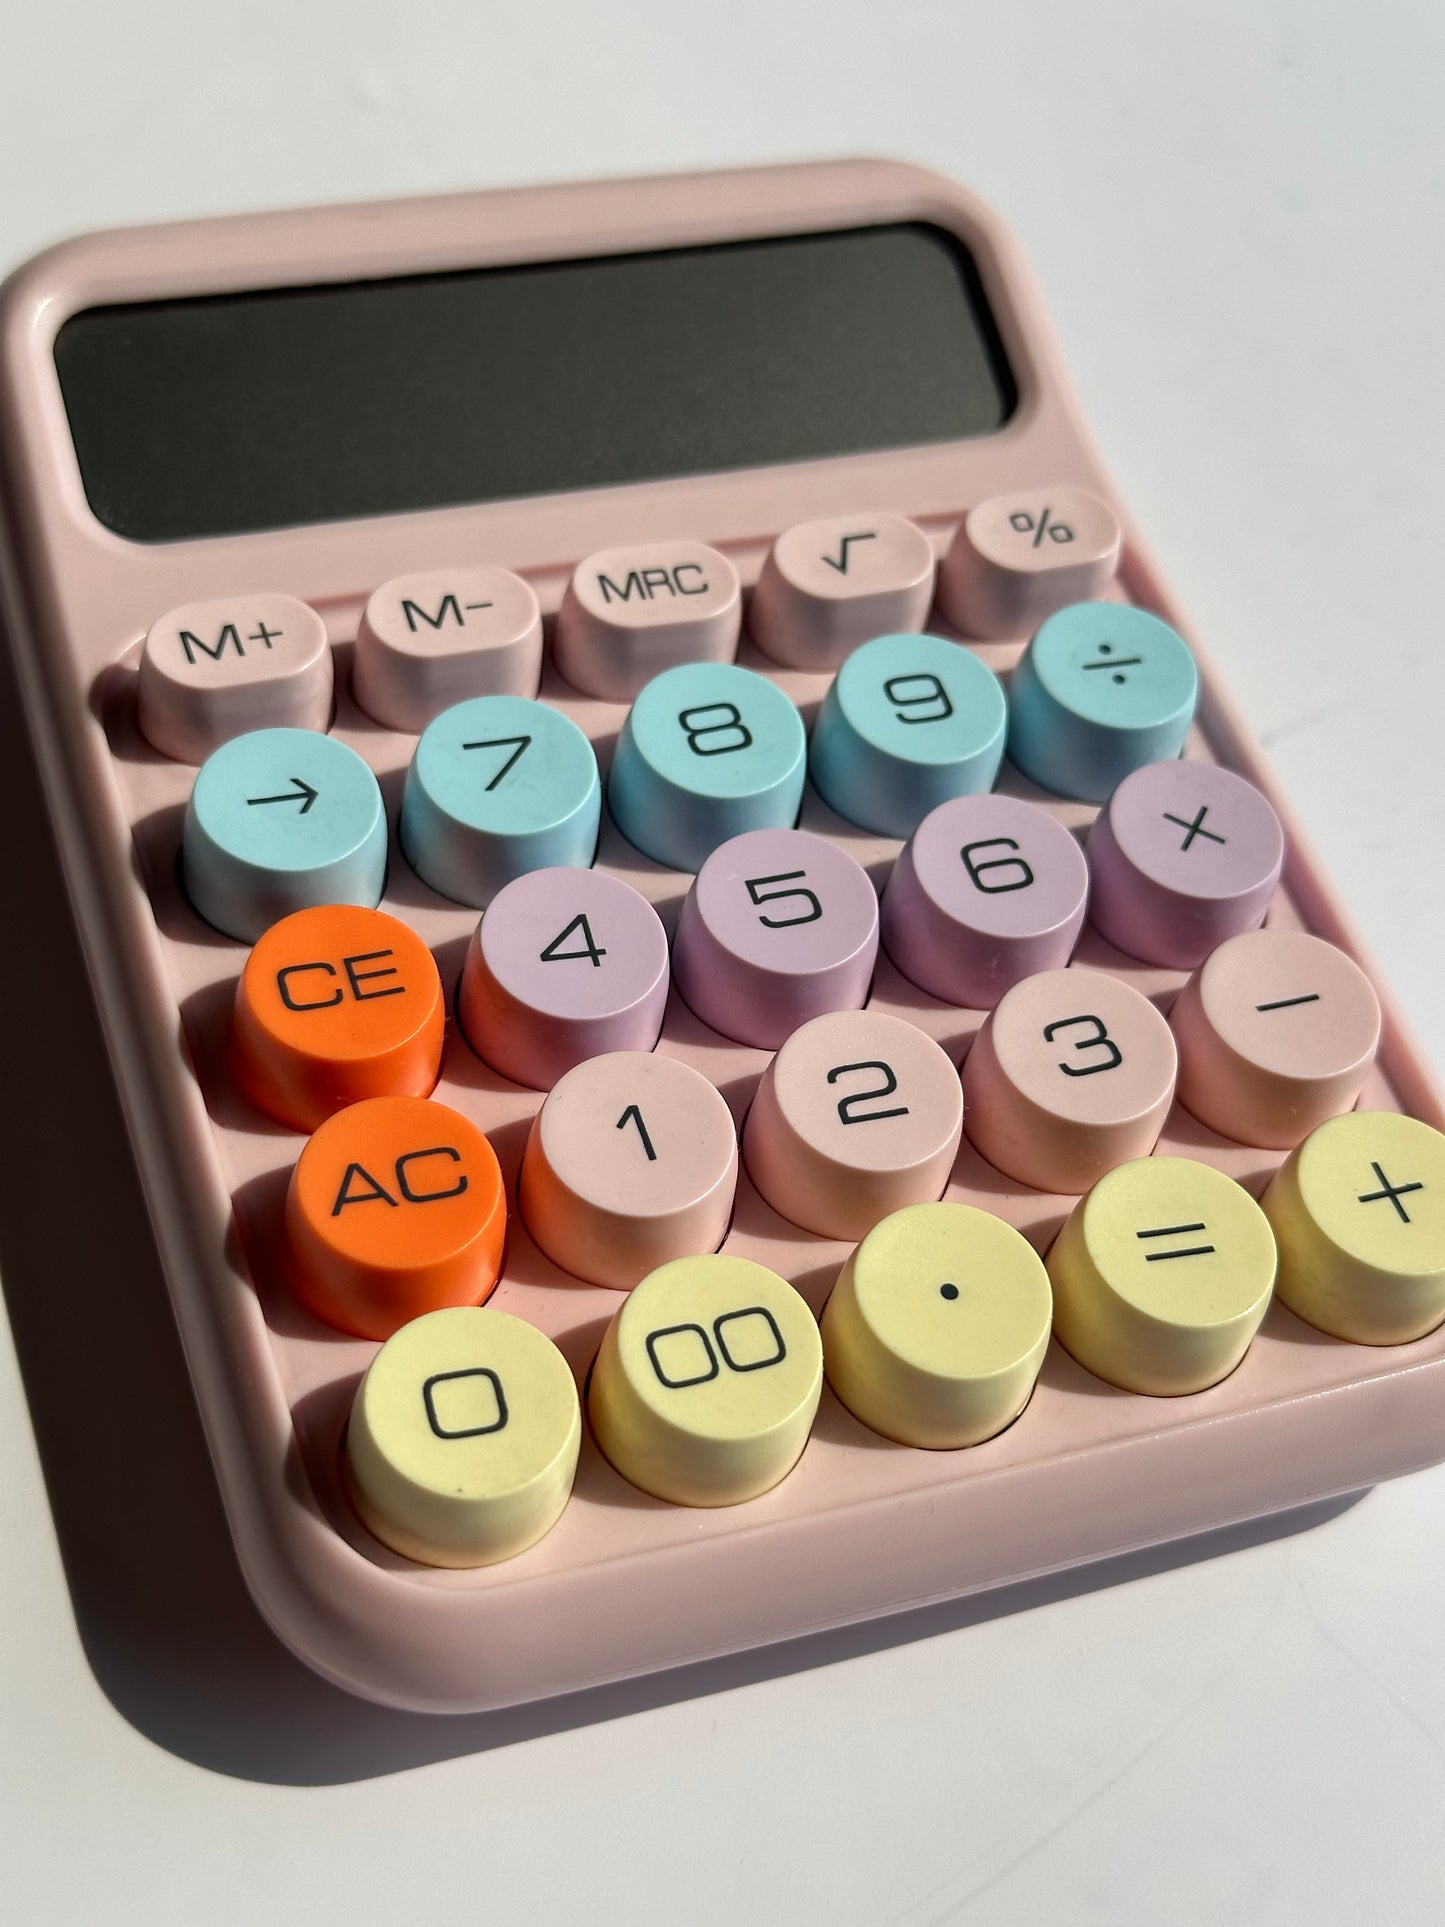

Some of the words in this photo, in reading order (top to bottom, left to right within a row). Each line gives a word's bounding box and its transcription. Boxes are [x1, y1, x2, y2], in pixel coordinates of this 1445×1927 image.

[1009, 509, 1075, 547] %
[598, 565, 709, 602] MRC
[179, 623, 283, 664] M+
[1083, 645, 1142, 684] ÷
[884, 674, 954, 724] 9
[679, 703, 753, 756] 8
[462, 736, 532, 791] 7
[961, 838, 1035, 894] 6
[745, 871, 823, 928] 5
[540, 914, 607, 967] 4
[277, 951, 406, 1011] CE
[1044, 1015, 1123, 1076] 3
[827, 1061, 910, 1125] 2
[616, 1105, 657, 1161] 1
[332, 1147, 469, 1216] AC
[1358, 1162, 1424, 1223] +
[1137, 1223, 1216, 1262] =
[646, 1307, 786, 1389] 00
[423, 1368, 509, 1440] 0
